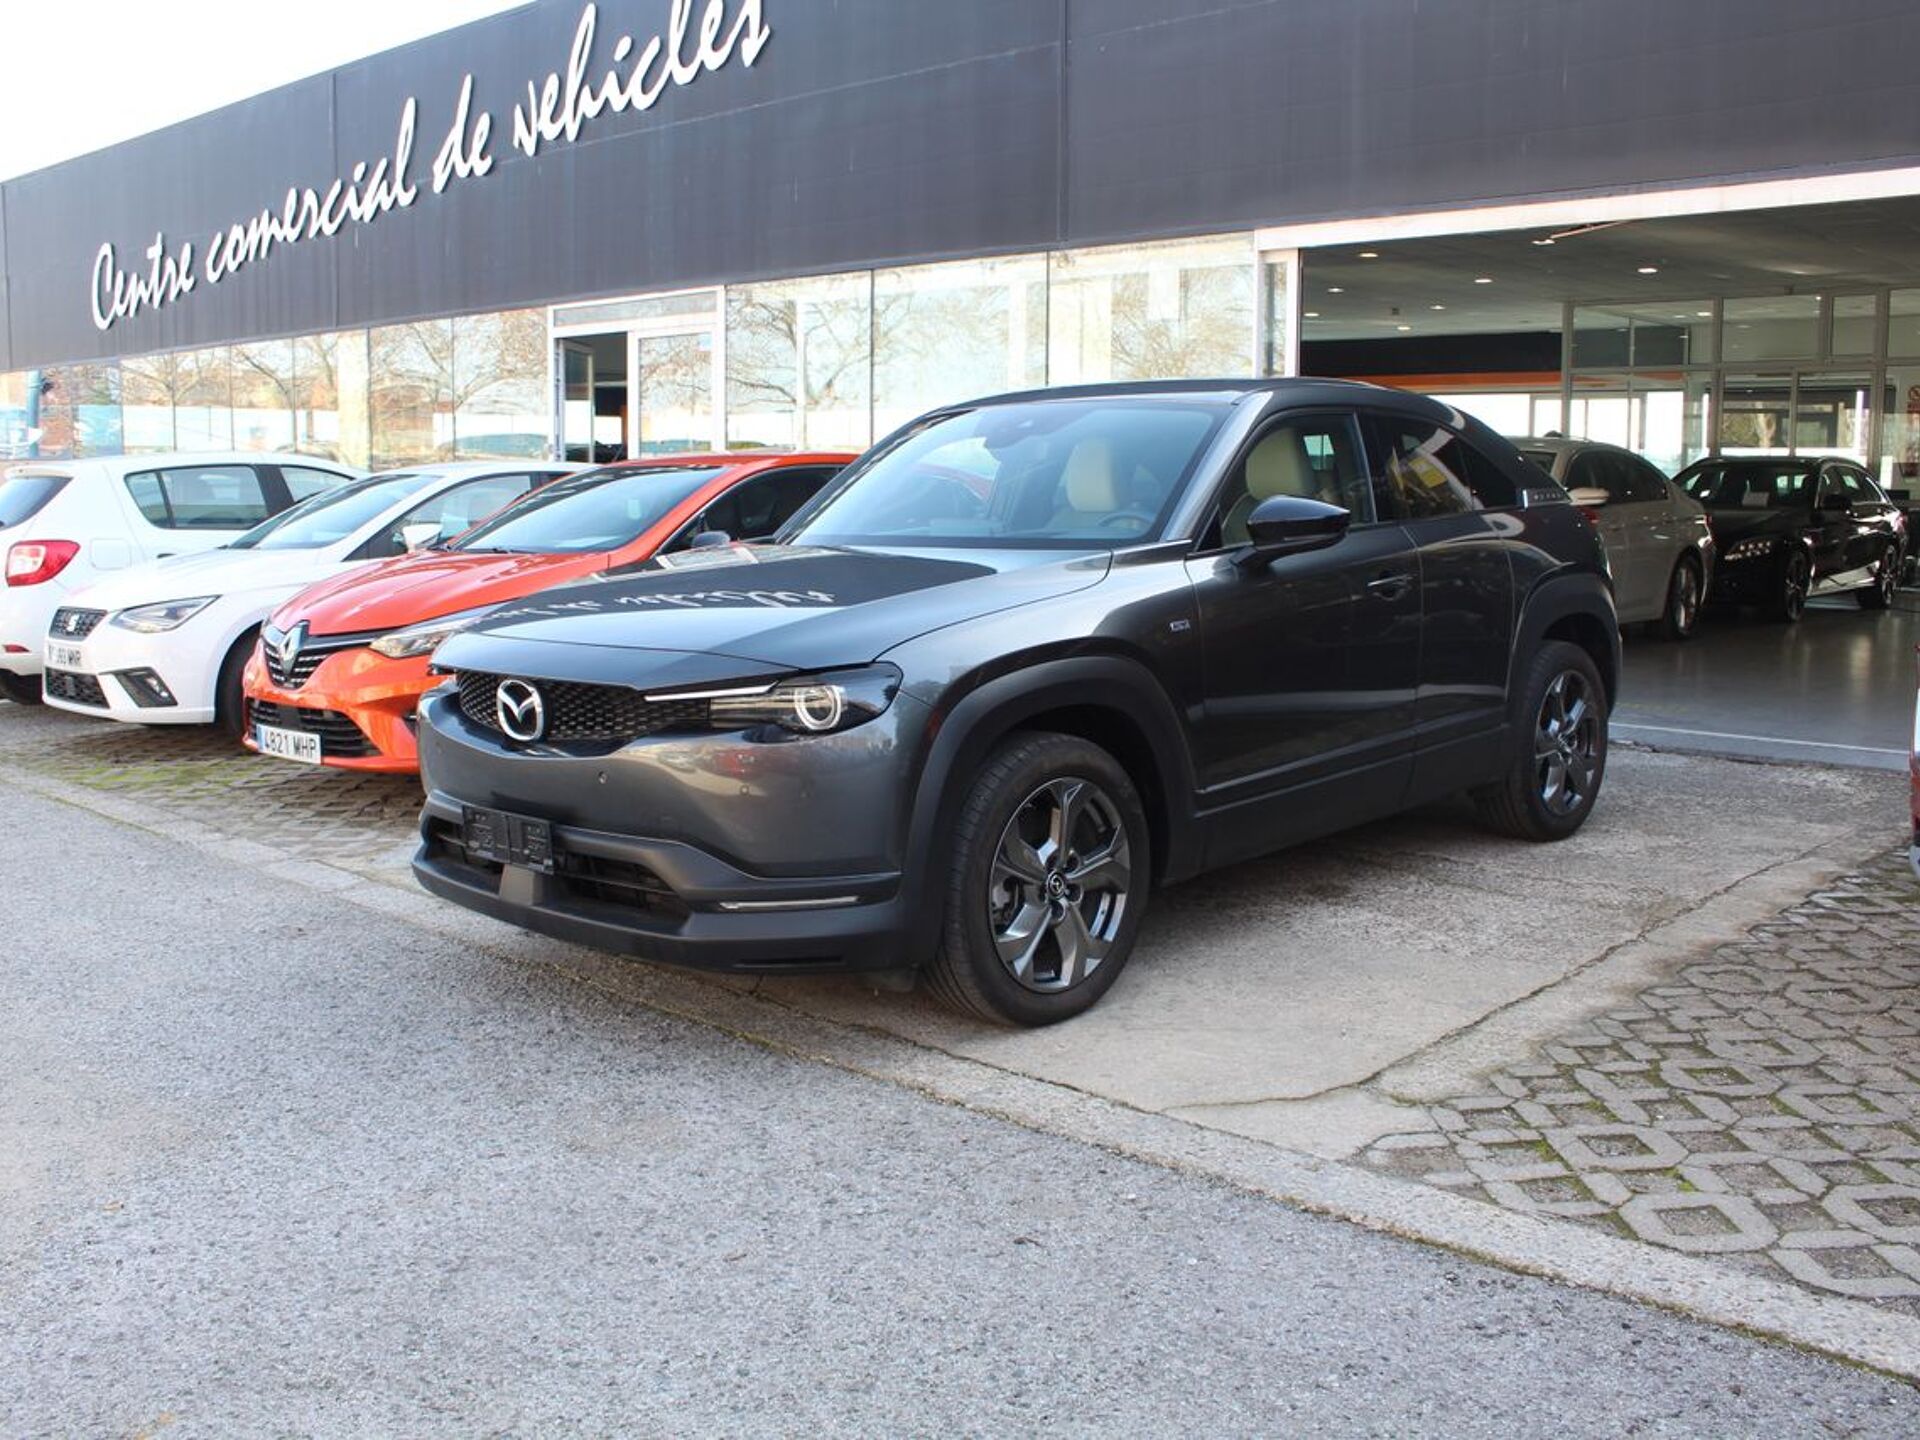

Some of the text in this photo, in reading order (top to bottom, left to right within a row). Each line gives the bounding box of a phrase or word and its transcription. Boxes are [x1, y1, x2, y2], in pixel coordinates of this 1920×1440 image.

[90, 0, 770, 331] Centre comercial de vehicles
[264, 730, 317, 758] 4821 MHP
